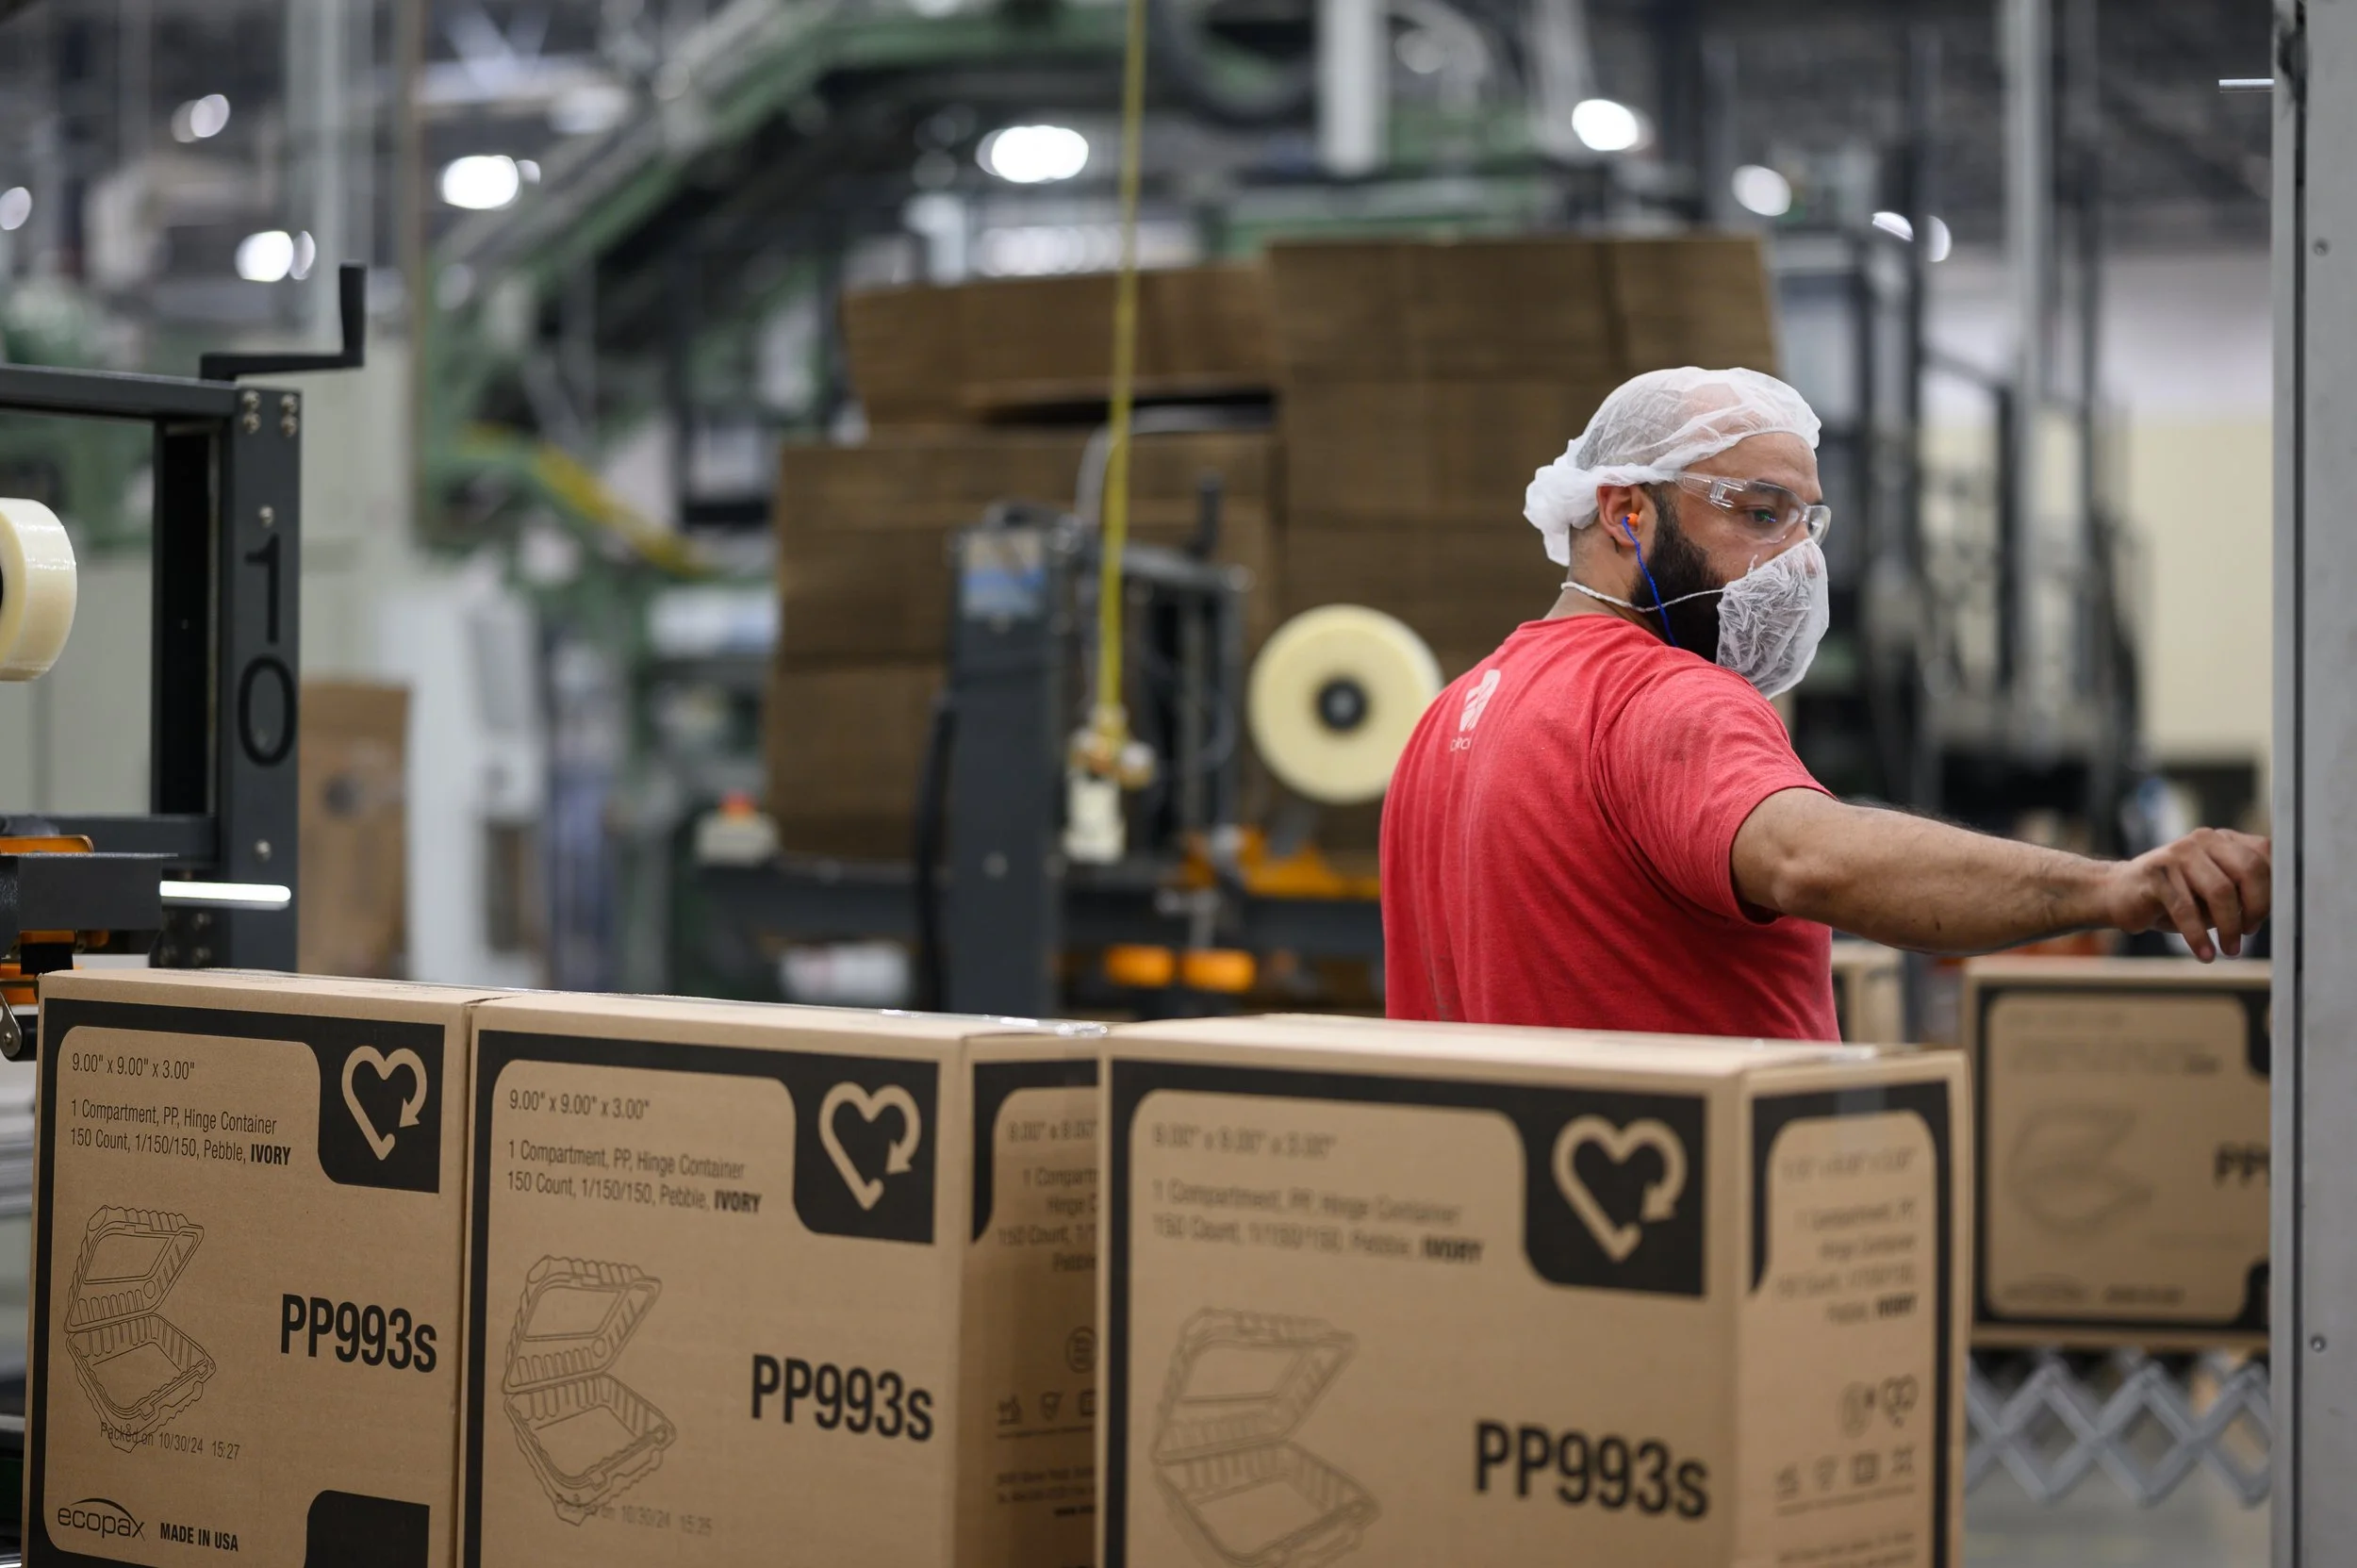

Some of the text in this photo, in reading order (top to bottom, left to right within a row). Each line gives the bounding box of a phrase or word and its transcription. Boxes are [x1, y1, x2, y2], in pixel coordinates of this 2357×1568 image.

[72, 1052, 195, 1080] 9.00" x 9.00" x 3.00"
[72, 1098, 277, 1135] 1 Compartment, PP, Hinge Container
[510, 1089, 651, 1120] 9.00" x 9.00" x 3.00"
[71, 1128, 292, 1165] 150 Count, 1/150/150, Pebble, IVORY
[508, 1140, 746, 1180] 1 Compartment, PP, Hinge Container
[507, 1172, 762, 1213] 150 Count, 1/150/150, Pebble, IVORY
[281, 1293, 437, 1373] PP993s
[751, 1353, 934, 1443] PP993s
[100, 1421, 240, 1461] Packed on 10/30/24 15:27
[1474, 1419, 1711, 1521] PP993s
[58, 1506, 146, 1543] ecopax
[160, 1522, 239, 1552] MADE IN USA
